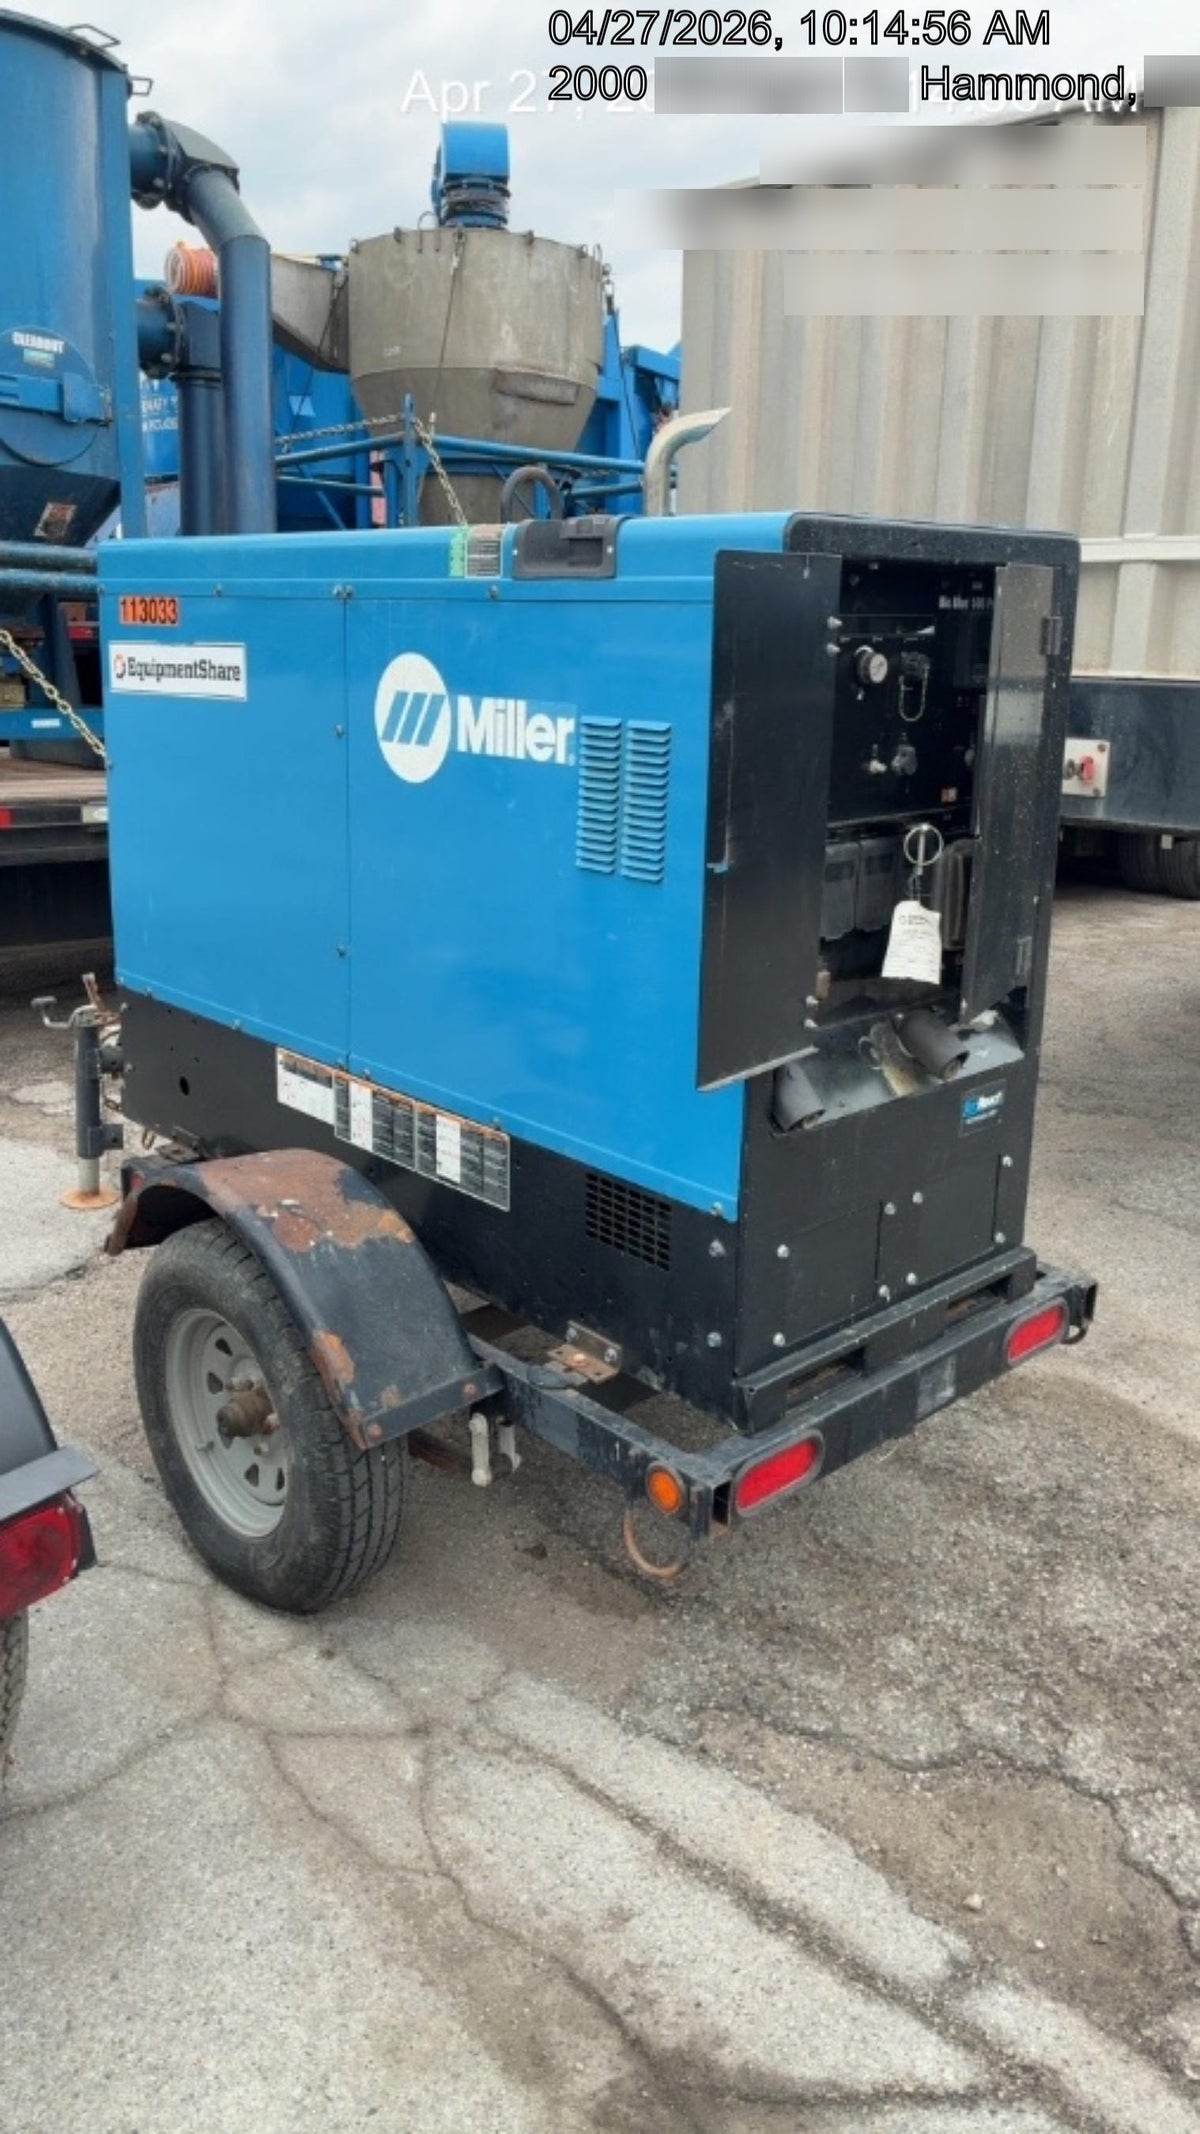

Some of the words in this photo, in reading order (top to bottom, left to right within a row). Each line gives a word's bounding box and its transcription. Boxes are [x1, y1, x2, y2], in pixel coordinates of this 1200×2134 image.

[121, 597, 177, 625] 113033
[127, 656, 241, 683] EquipmentShare
[457, 694, 576, 765] Miller
